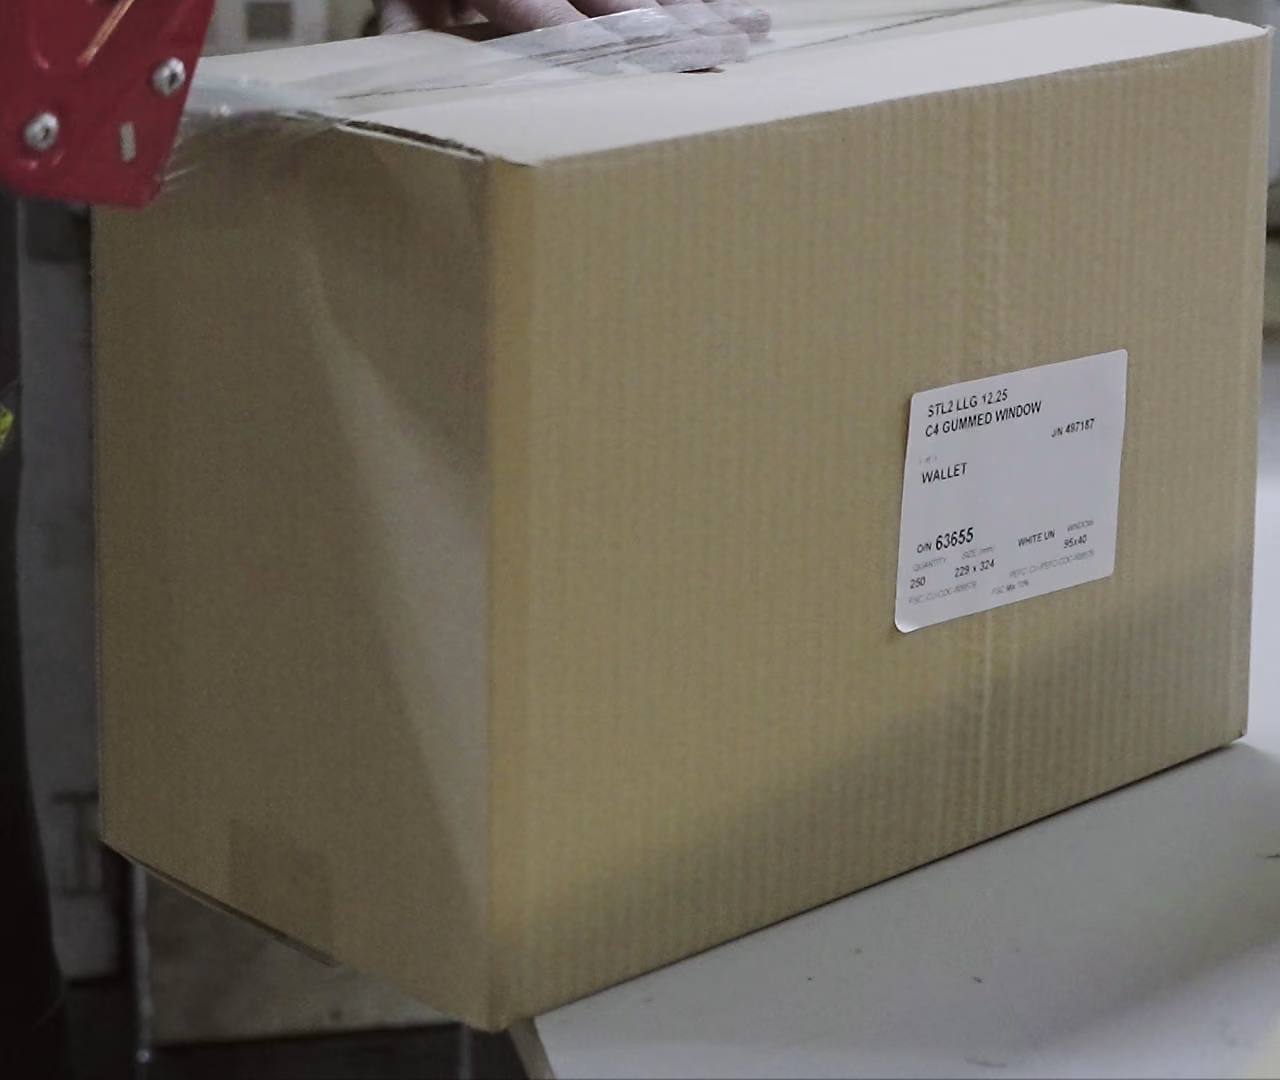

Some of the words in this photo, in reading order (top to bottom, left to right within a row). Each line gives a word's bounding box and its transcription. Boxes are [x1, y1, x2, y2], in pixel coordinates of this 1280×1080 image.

[928, 400, 953, 417] STL2
[956, 395, 977, 411] LLG
[982, 388, 1008, 405] 12.25
[925, 423, 939, 437] C4
[942, 411, 992, 433] GUMMED
[995, 401, 1042, 422] WINDOW
[922, 462, 967, 484] WALLET
[935, 526, 973, 551] 63655
[1018, 532, 1042, 548] WHITE
[954, 565, 970, 578] 229
[979, 558, 995, 571] 324
[910, 576, 926, 589] 250
